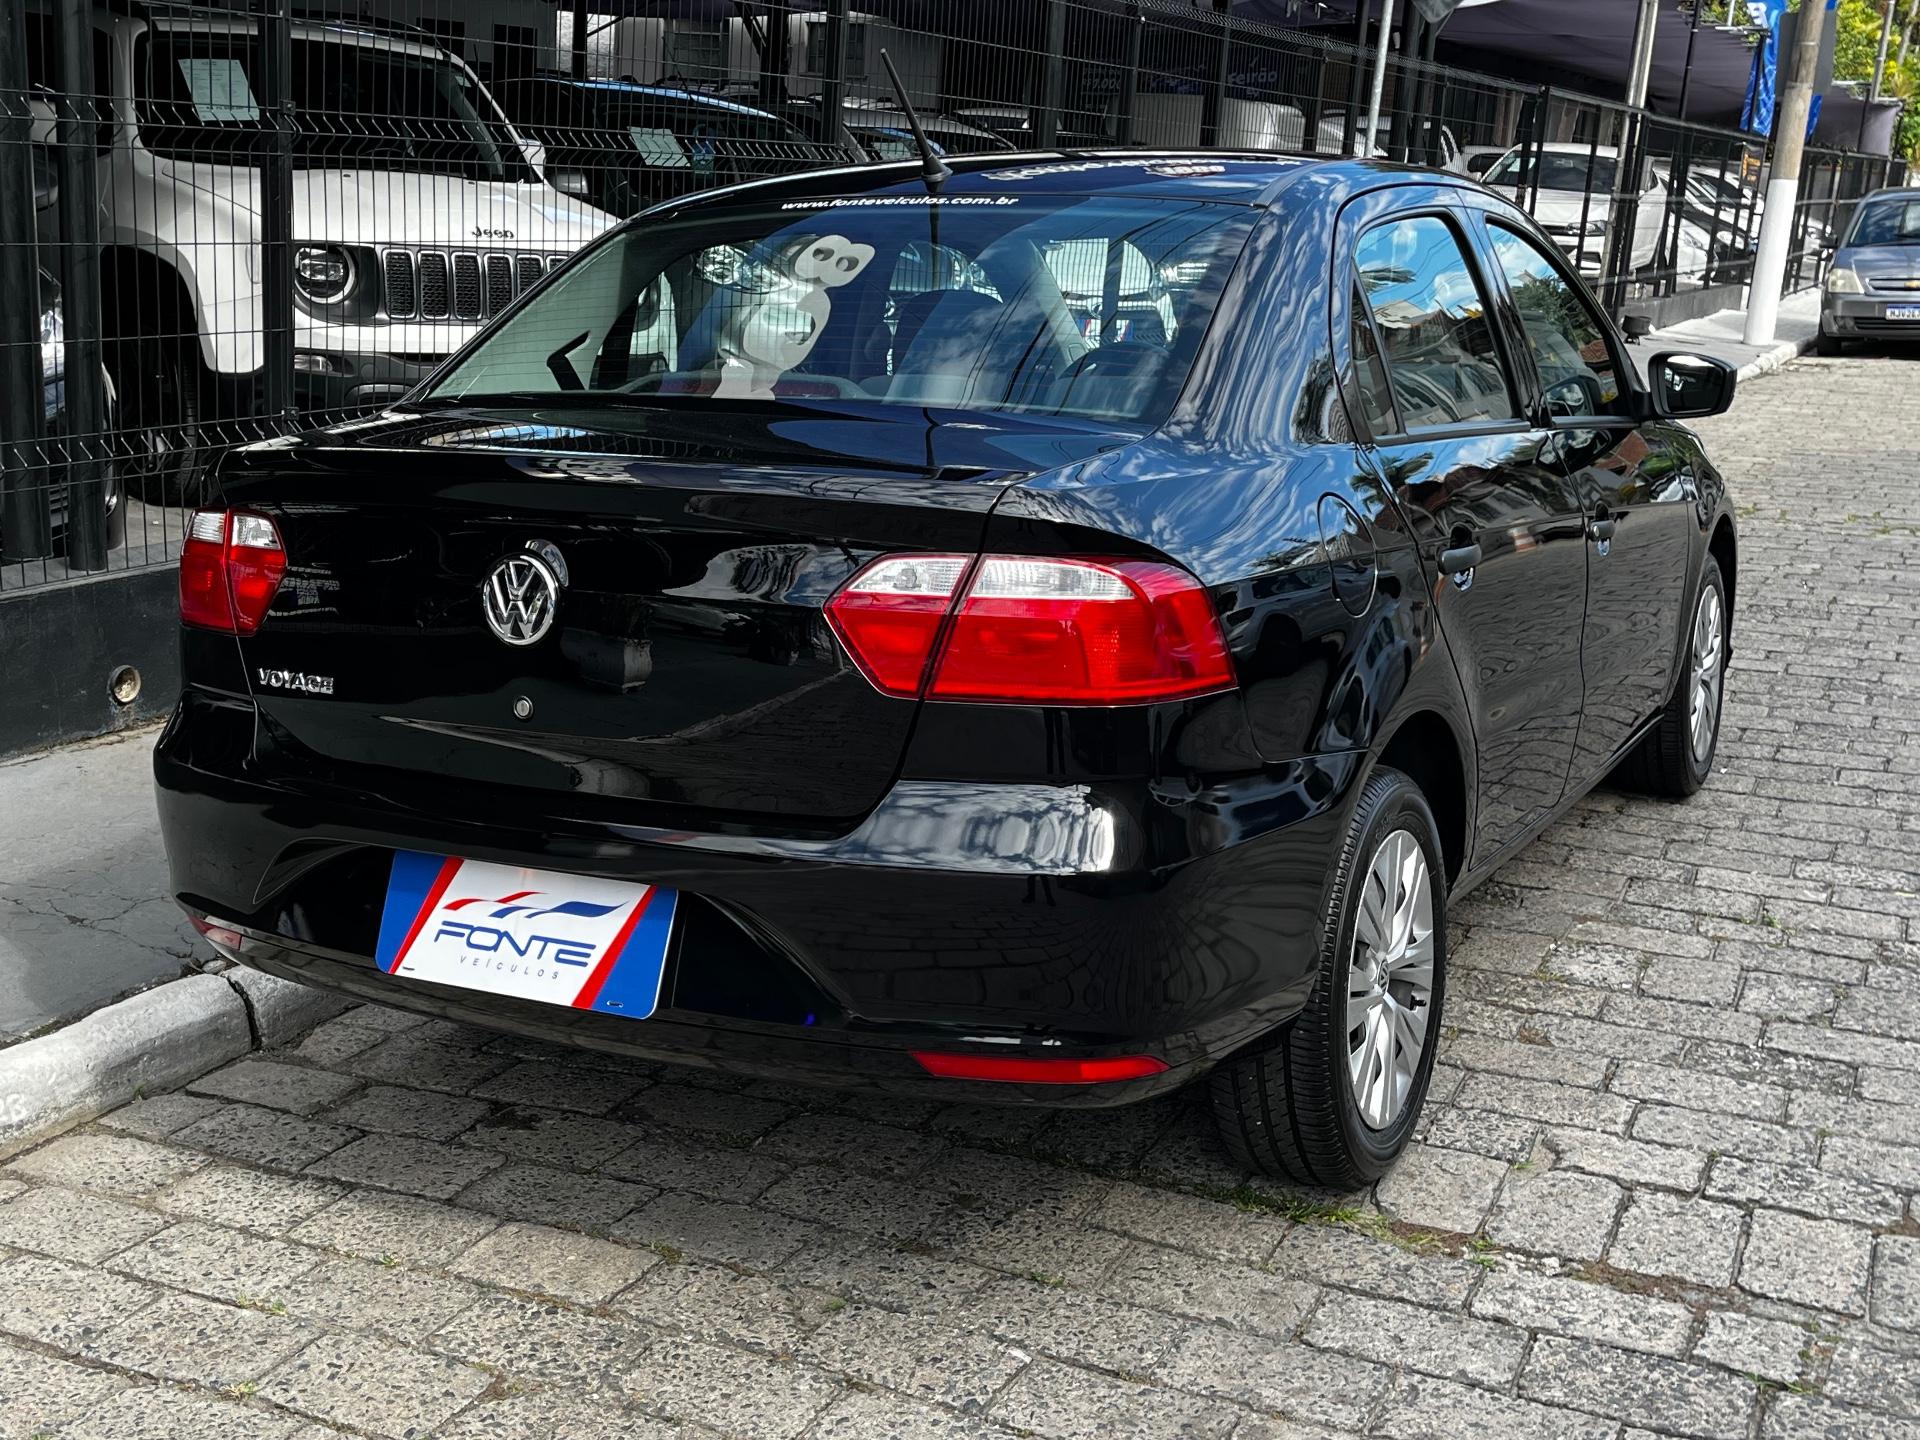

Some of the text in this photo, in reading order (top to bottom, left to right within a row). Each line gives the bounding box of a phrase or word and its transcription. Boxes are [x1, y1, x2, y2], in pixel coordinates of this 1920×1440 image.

[781, 196, 1019, 210] www.fonteveiculos.com.br
[257, 667, 334, 695] VOYAGE
[433, 920, 597, 968] FONTE
